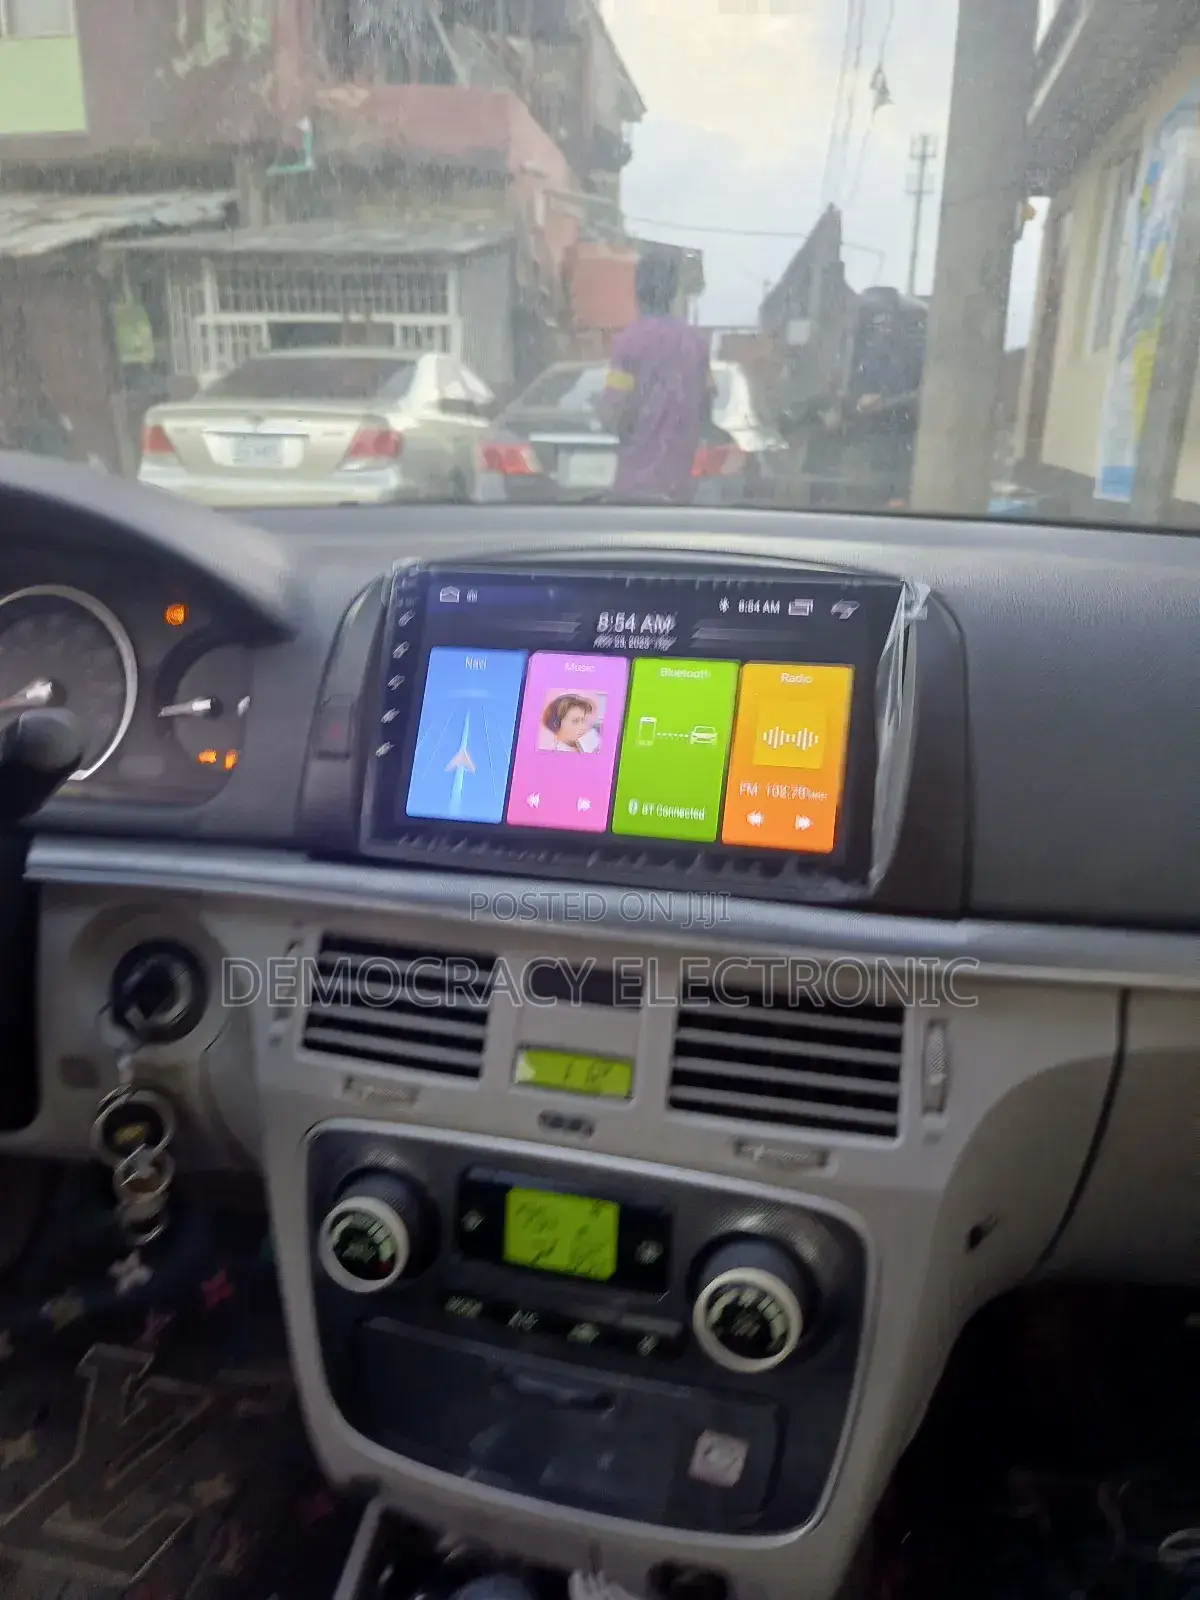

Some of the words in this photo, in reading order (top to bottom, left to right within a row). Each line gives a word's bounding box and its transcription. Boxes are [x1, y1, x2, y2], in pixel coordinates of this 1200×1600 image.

[762, 599, 781, 615] AM
[640, 612, 677, 634] AM
[465, 655, 488, 671] Navi
[564, 660, 596, 673] Music
[660, 667, 712, 679] Bluetooth
[780, 672, 813, 684] Radio
[739, 781, 759, 797] FM
[656, 803, 705, 821] Connected
